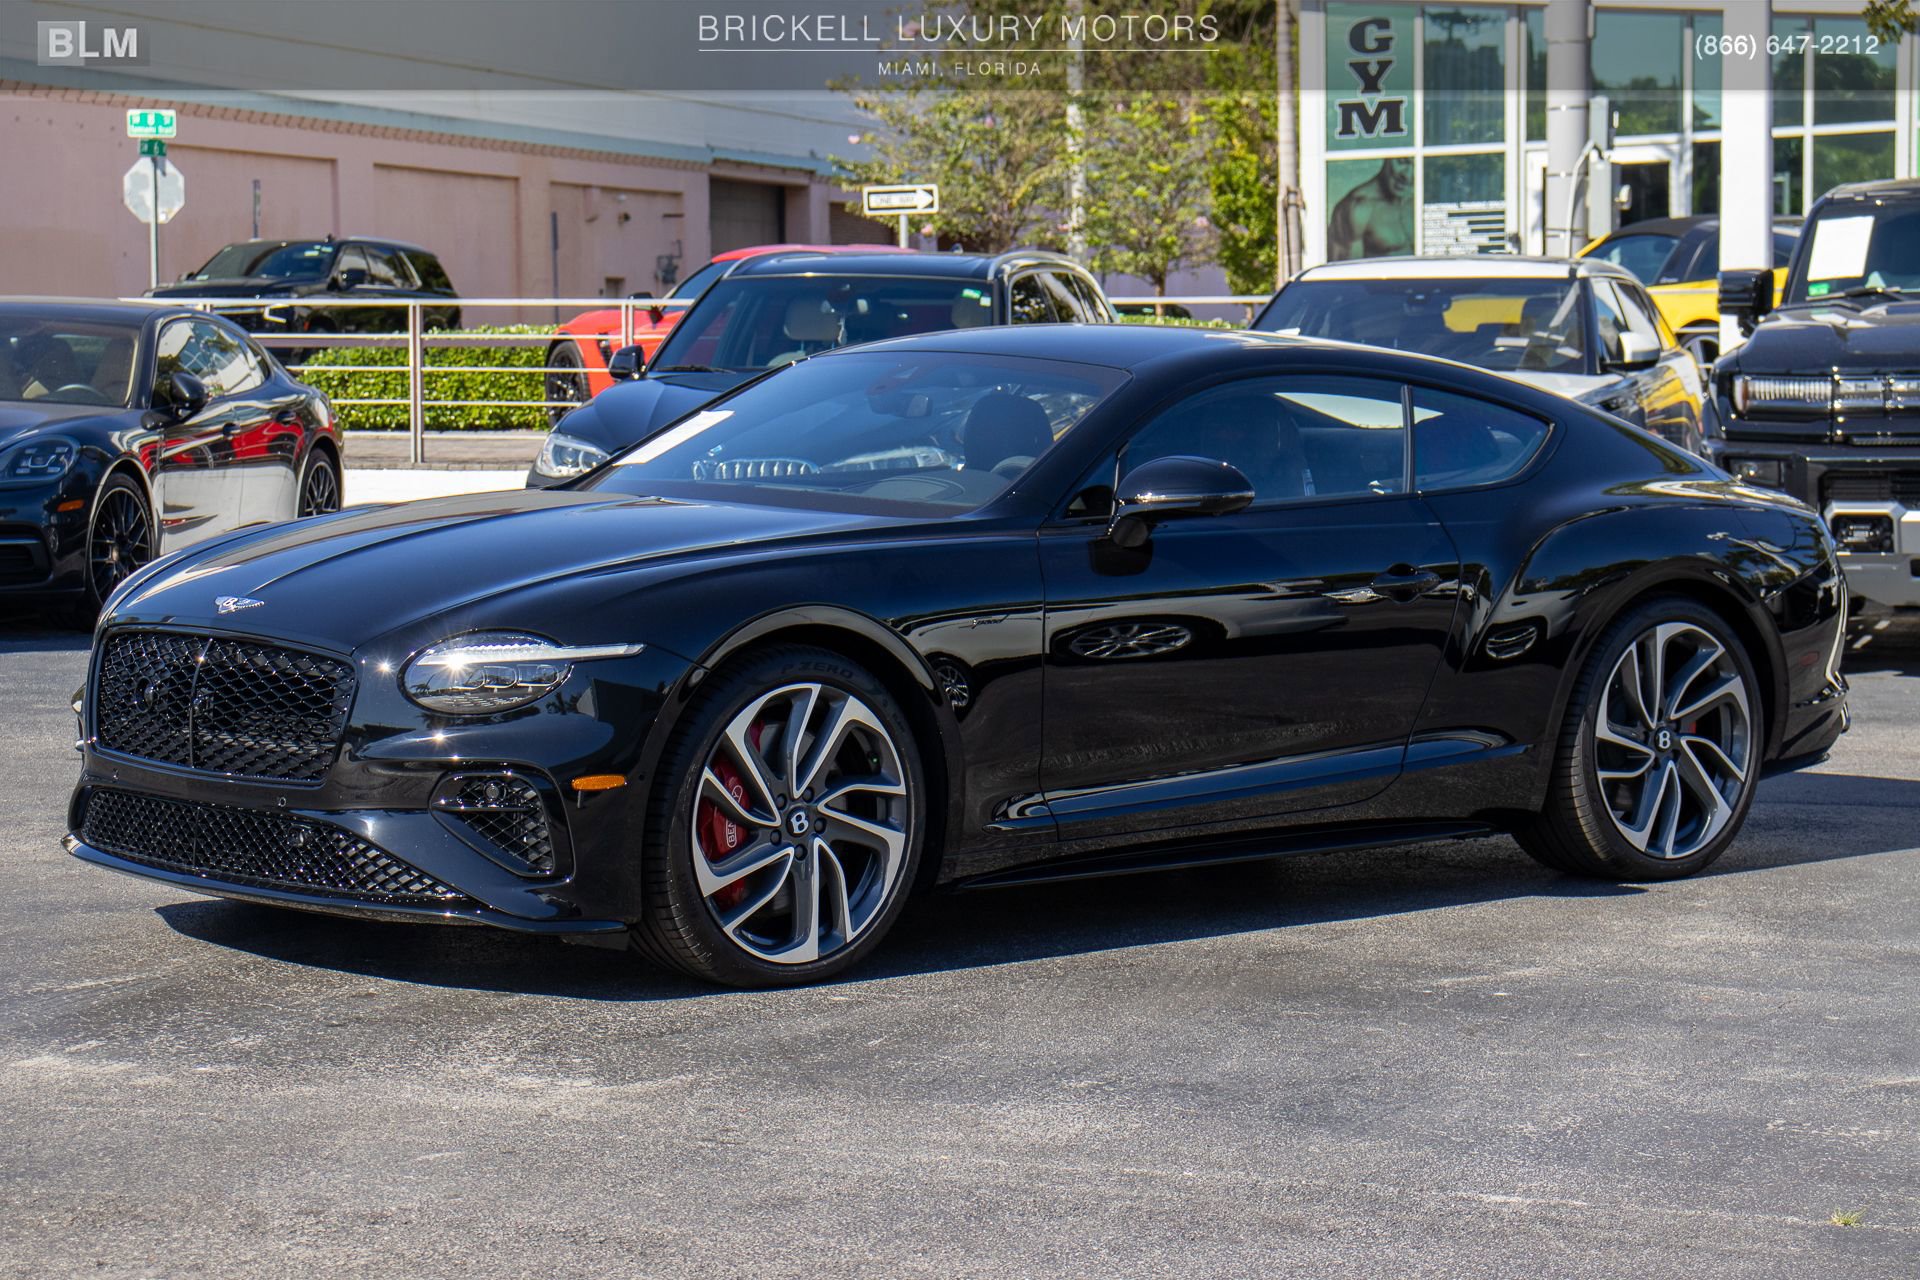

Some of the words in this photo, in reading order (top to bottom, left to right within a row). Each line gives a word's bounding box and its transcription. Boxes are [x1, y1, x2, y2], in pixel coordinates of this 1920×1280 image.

[1337, 17, 1405, 136] GYM
[1658, 730, 1671, 749] B
[790, 811, 809, 834] B
